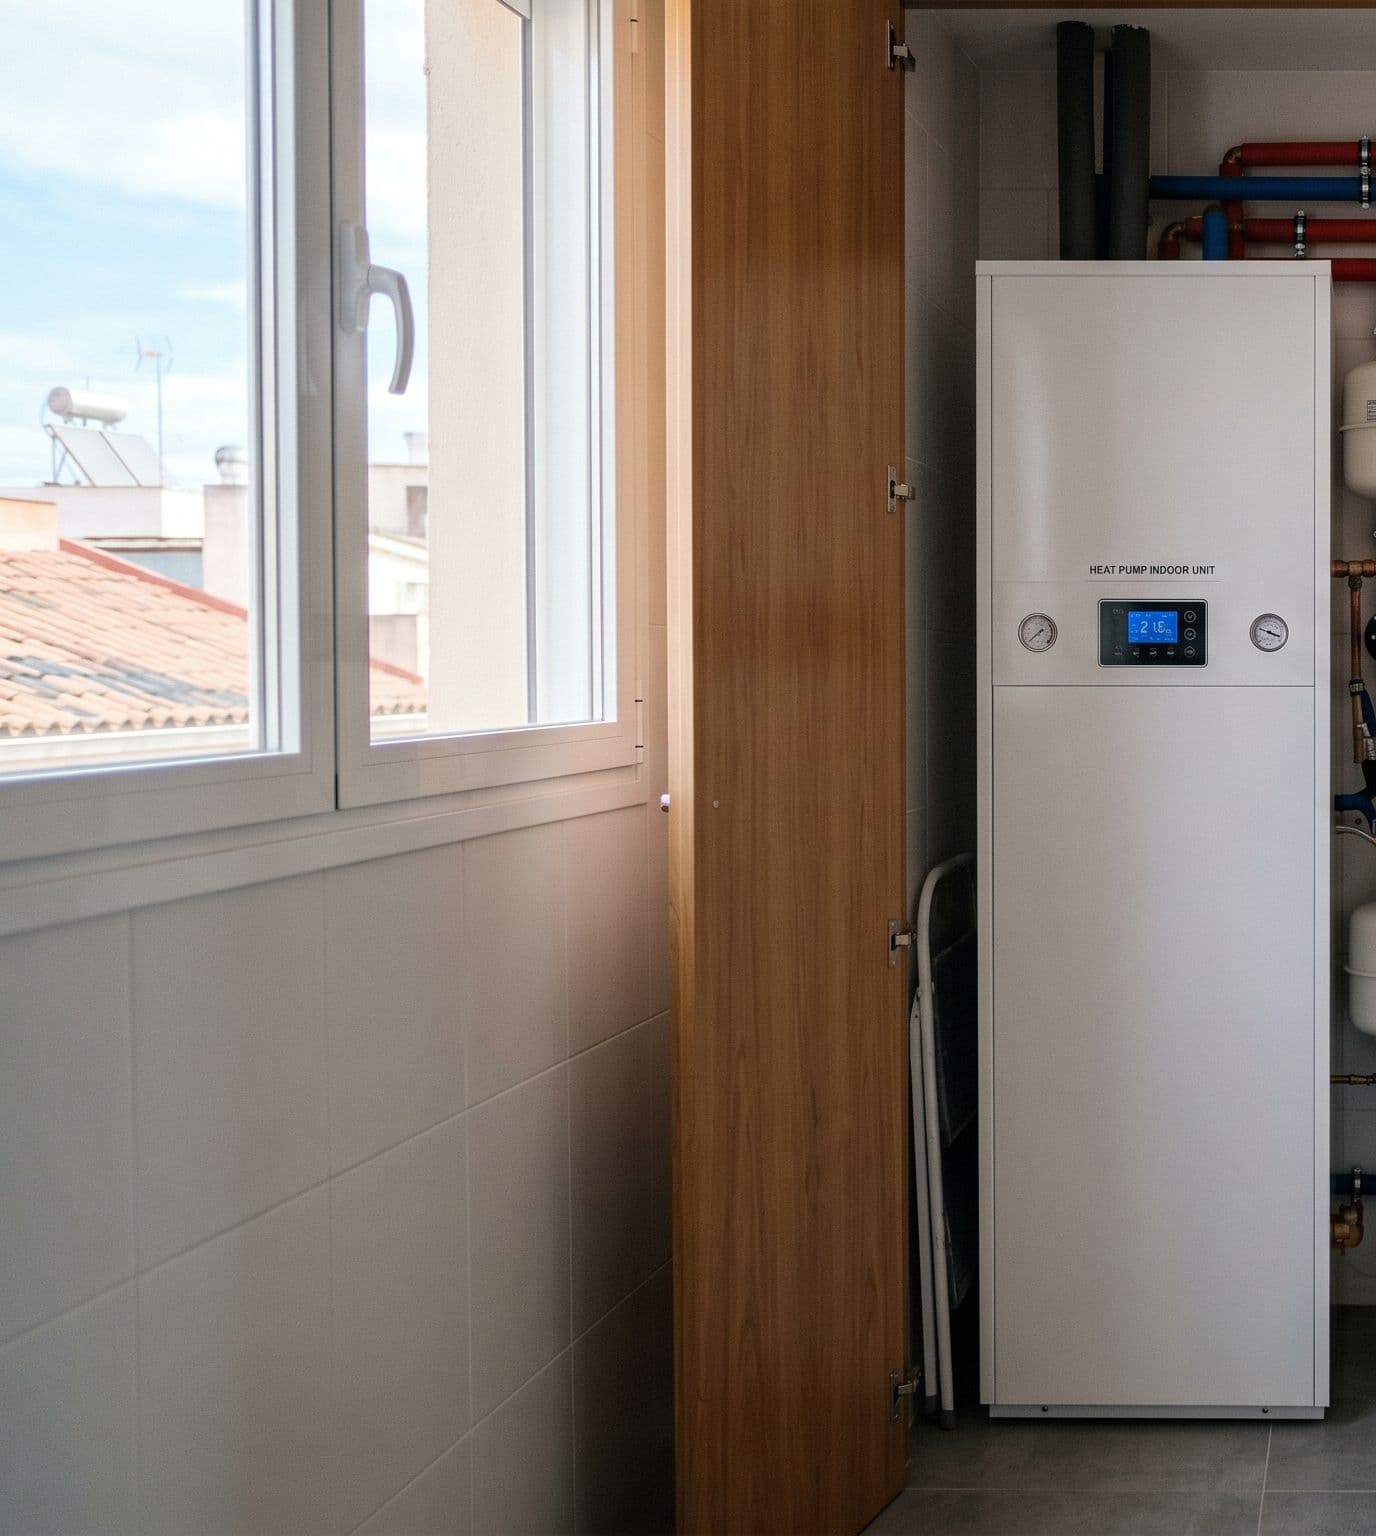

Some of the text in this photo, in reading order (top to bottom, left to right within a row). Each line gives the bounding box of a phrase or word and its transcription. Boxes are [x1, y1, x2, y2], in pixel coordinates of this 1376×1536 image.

[1090, 565, 1216, 575] HEAT PUMP INDOOR UNIT
